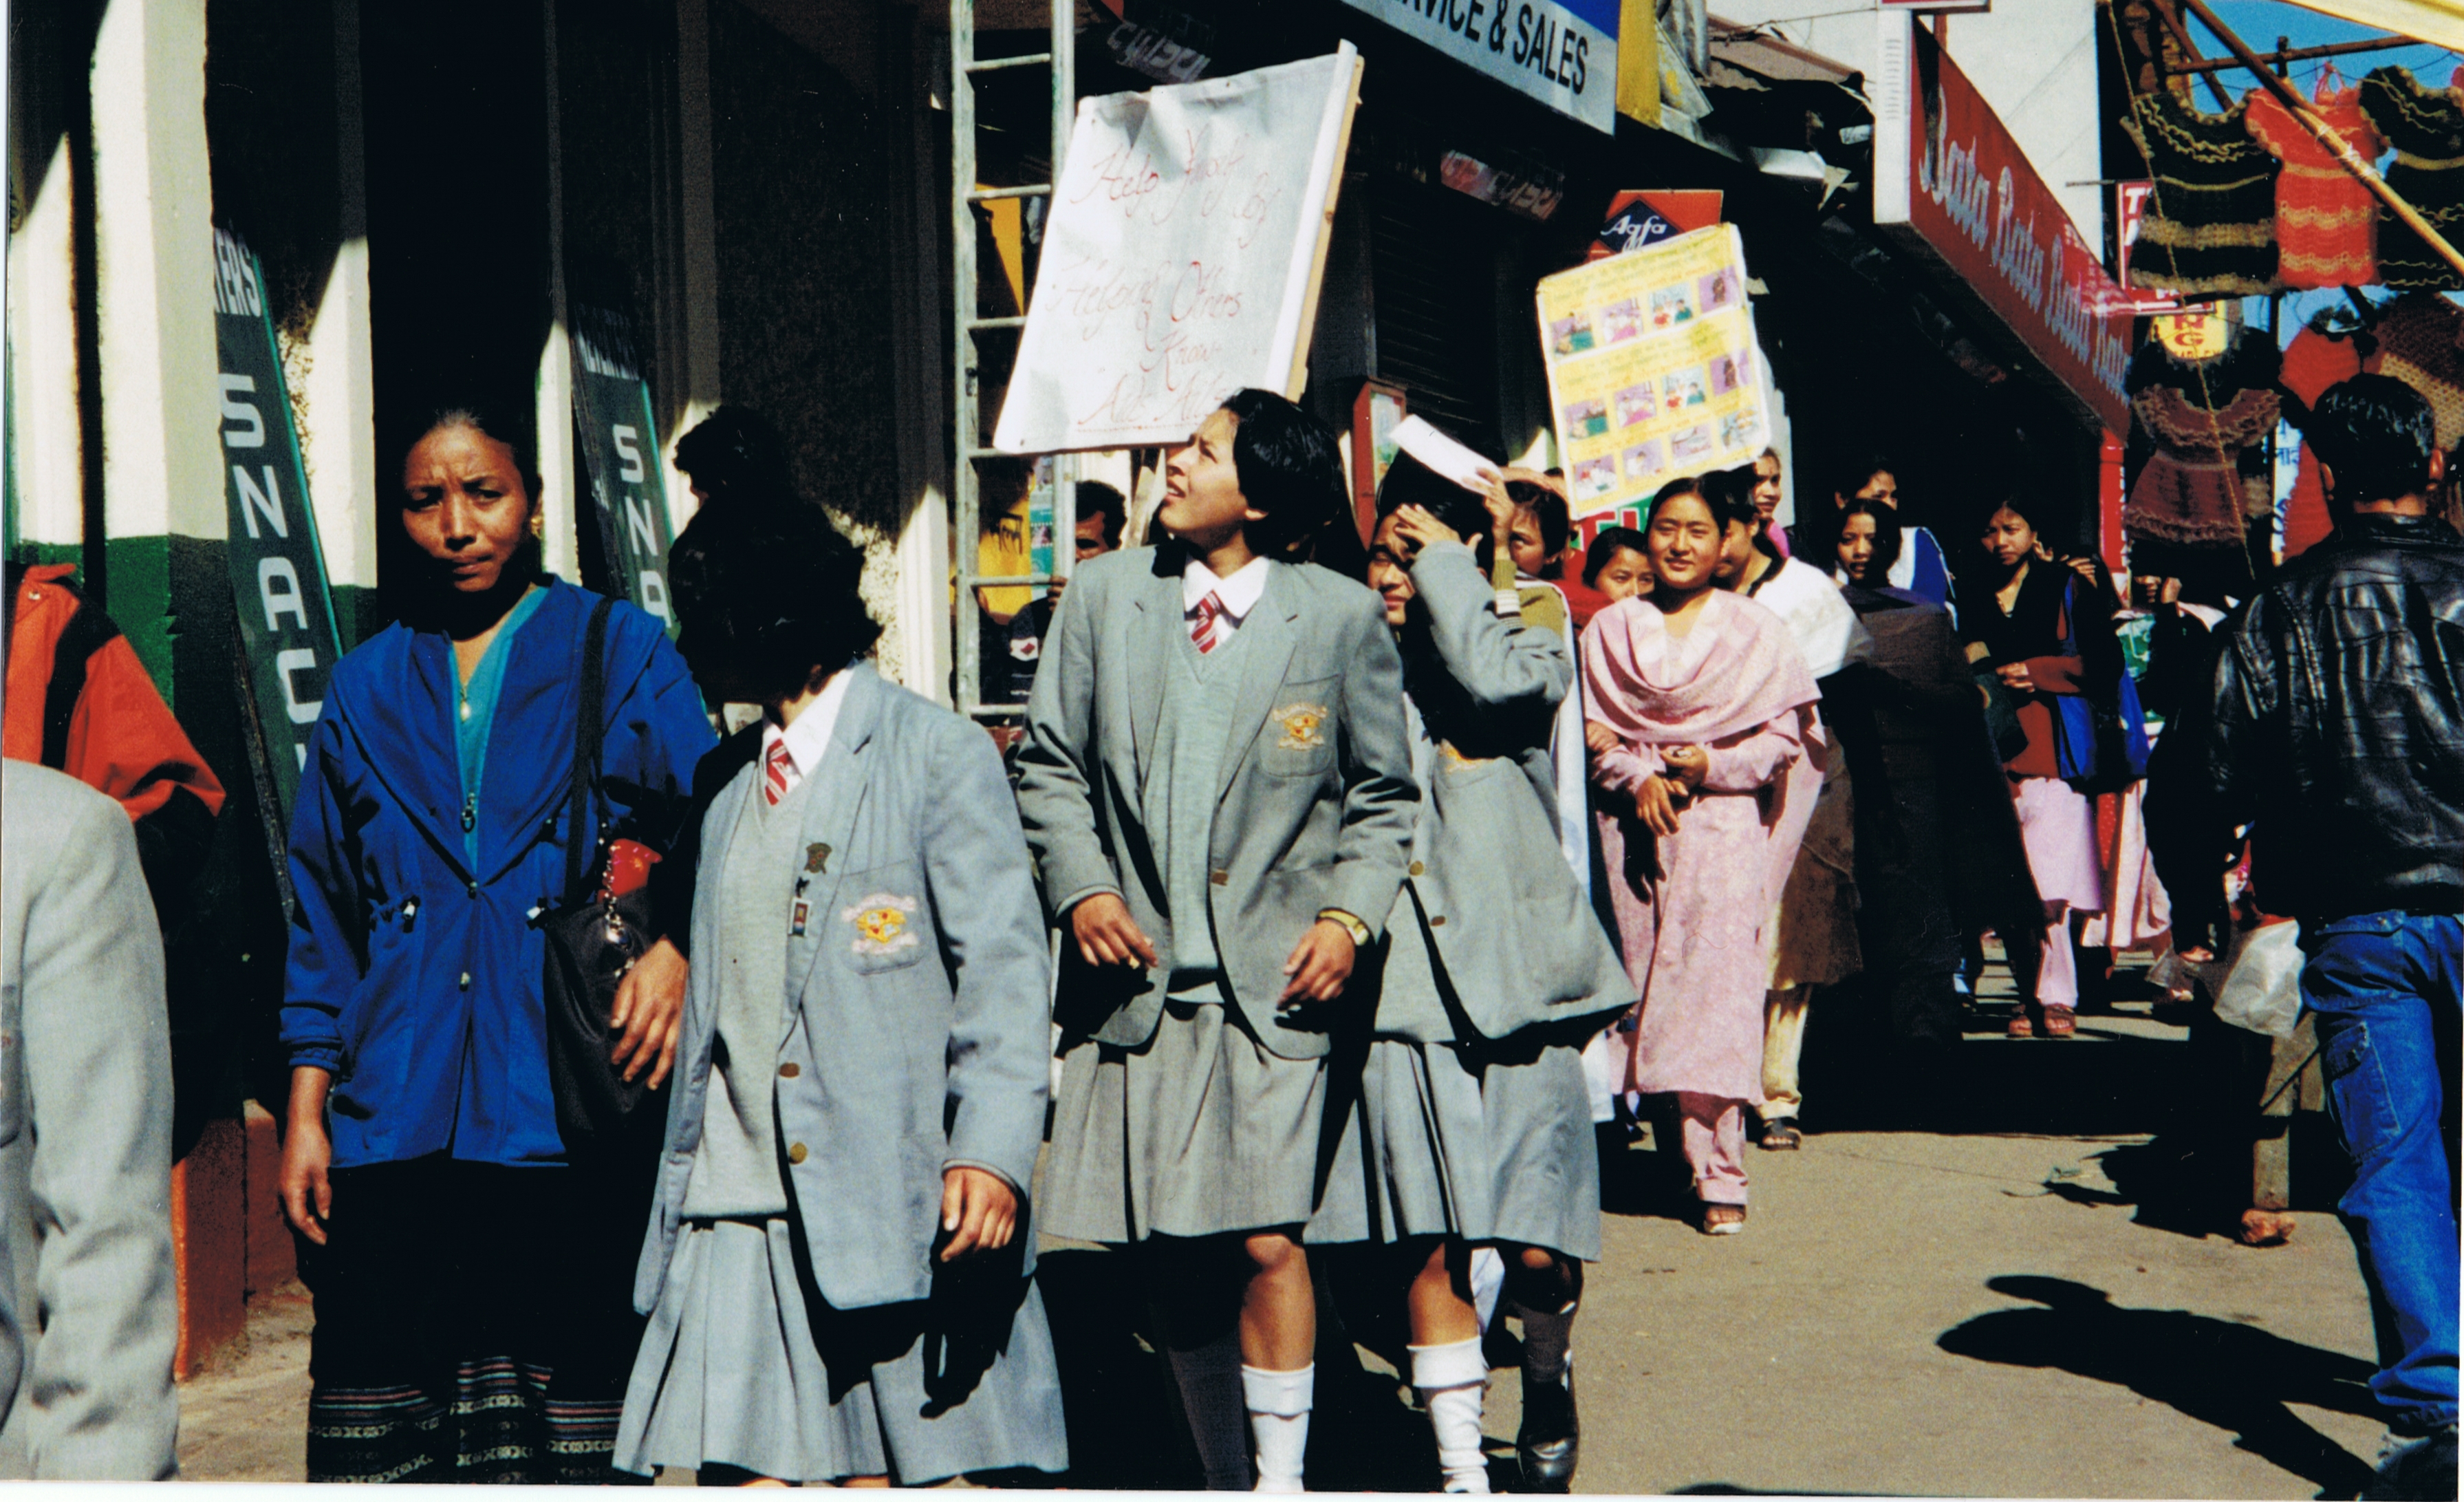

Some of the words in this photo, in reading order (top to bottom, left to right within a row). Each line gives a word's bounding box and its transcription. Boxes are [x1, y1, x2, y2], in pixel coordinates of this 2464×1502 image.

[1489, 0, 1509, 55] &
[1514, 3, 1588, 95] SALES
[1070, 142, 1159, 217] Help
[1600, 214, 1667, 253] Agfa
[1991, 165, 2044, 315] Bata
[218, 372, 325, 773] SNAC
